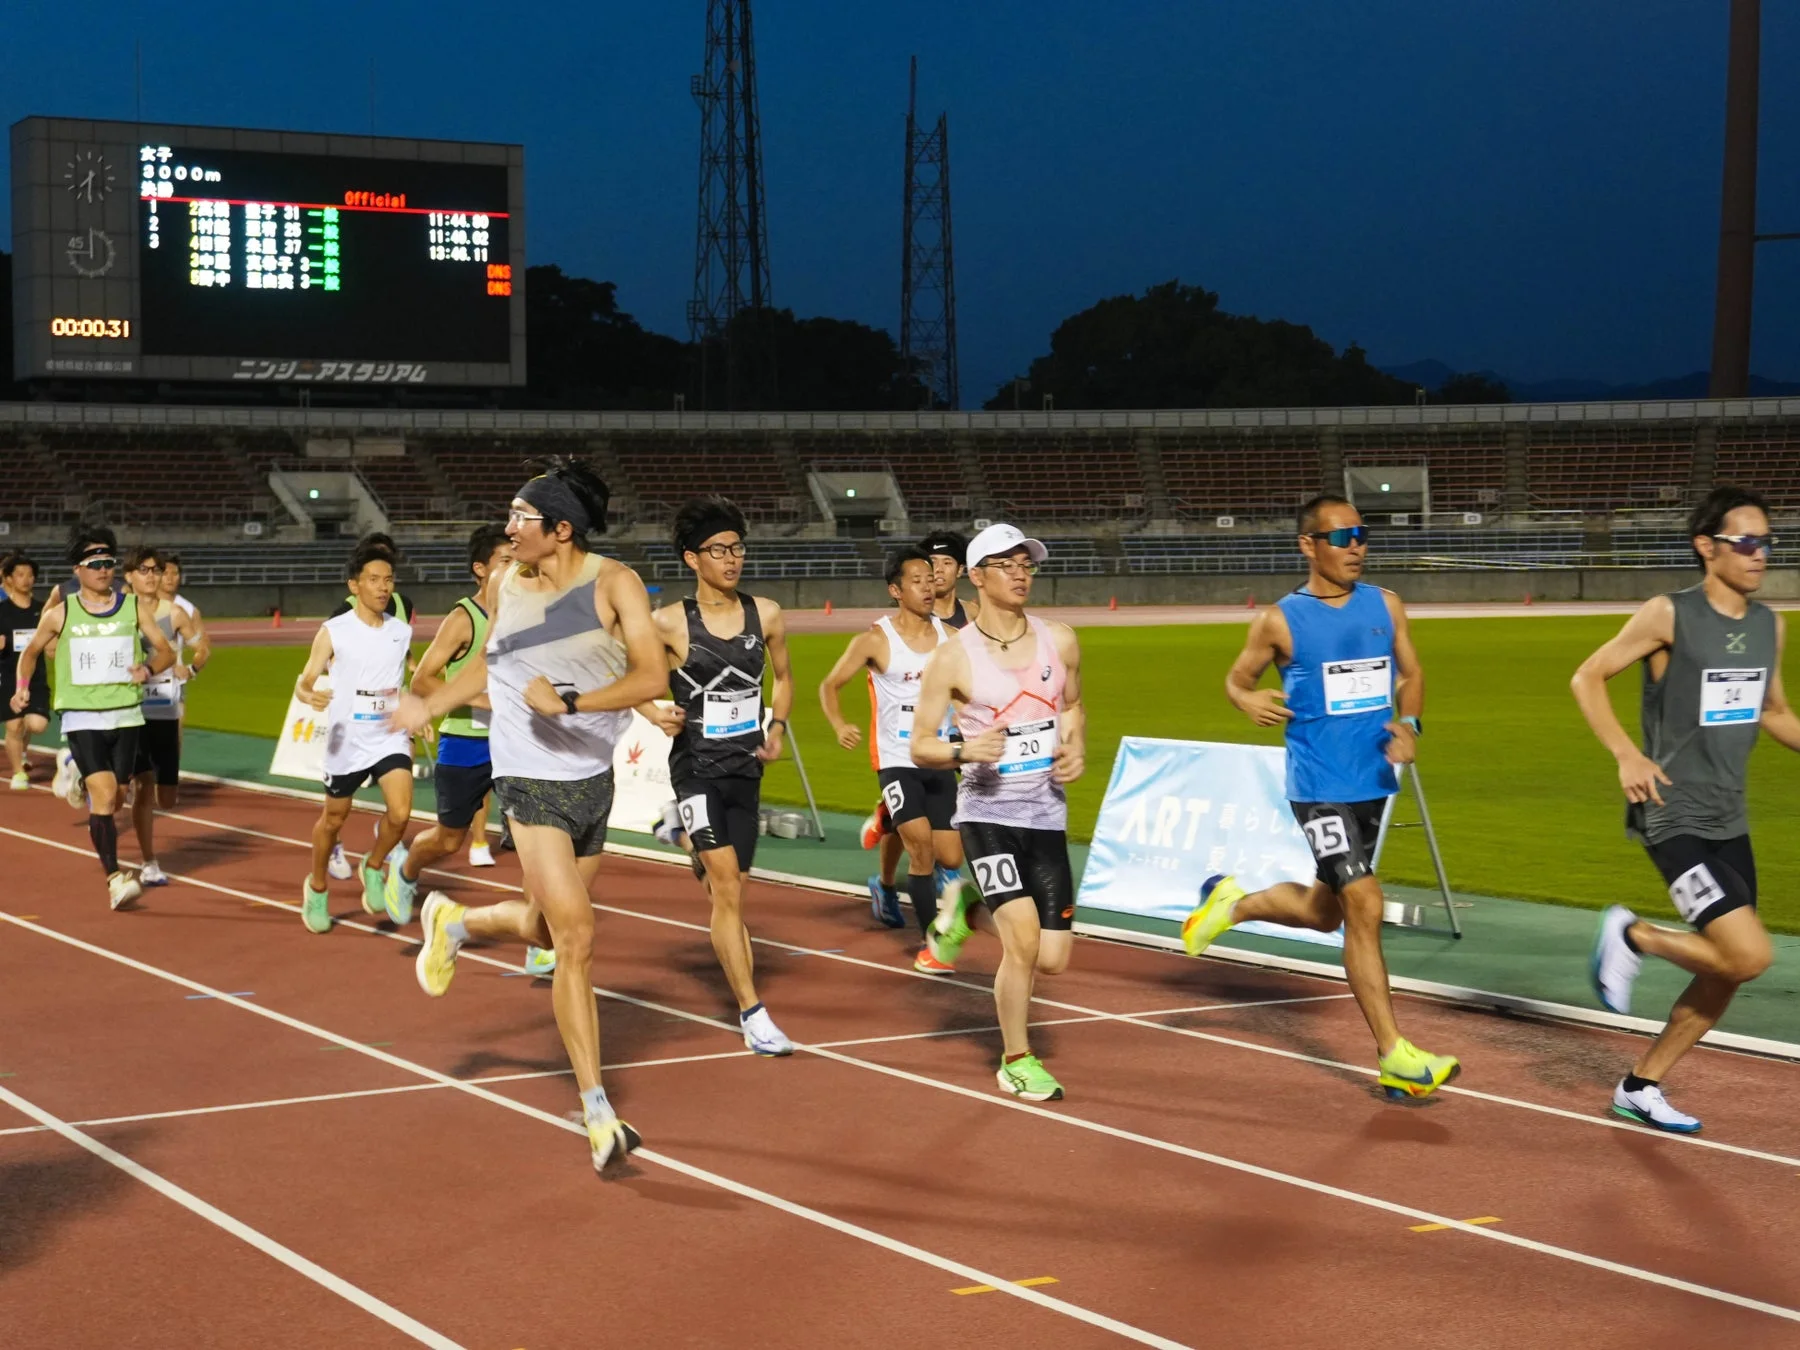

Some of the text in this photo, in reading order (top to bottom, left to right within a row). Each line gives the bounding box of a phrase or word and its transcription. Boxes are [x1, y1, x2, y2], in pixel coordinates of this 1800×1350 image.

[345, 191, 406, 208] Official
[52, 318, 129, 338] 00:00.31
[233, 360, 427, 382] ニンジニアスタジアム
[372, 701, 385, 711] 13
[731, 707, 738, 719] 9
[1020, 740, 1040, 756] 20
[888, 786, 901, 810] 5
[682, 804, 693, 830] 9
[1117, 796, 1210, 850] ART
[977, 857, 1017, 893] 20
